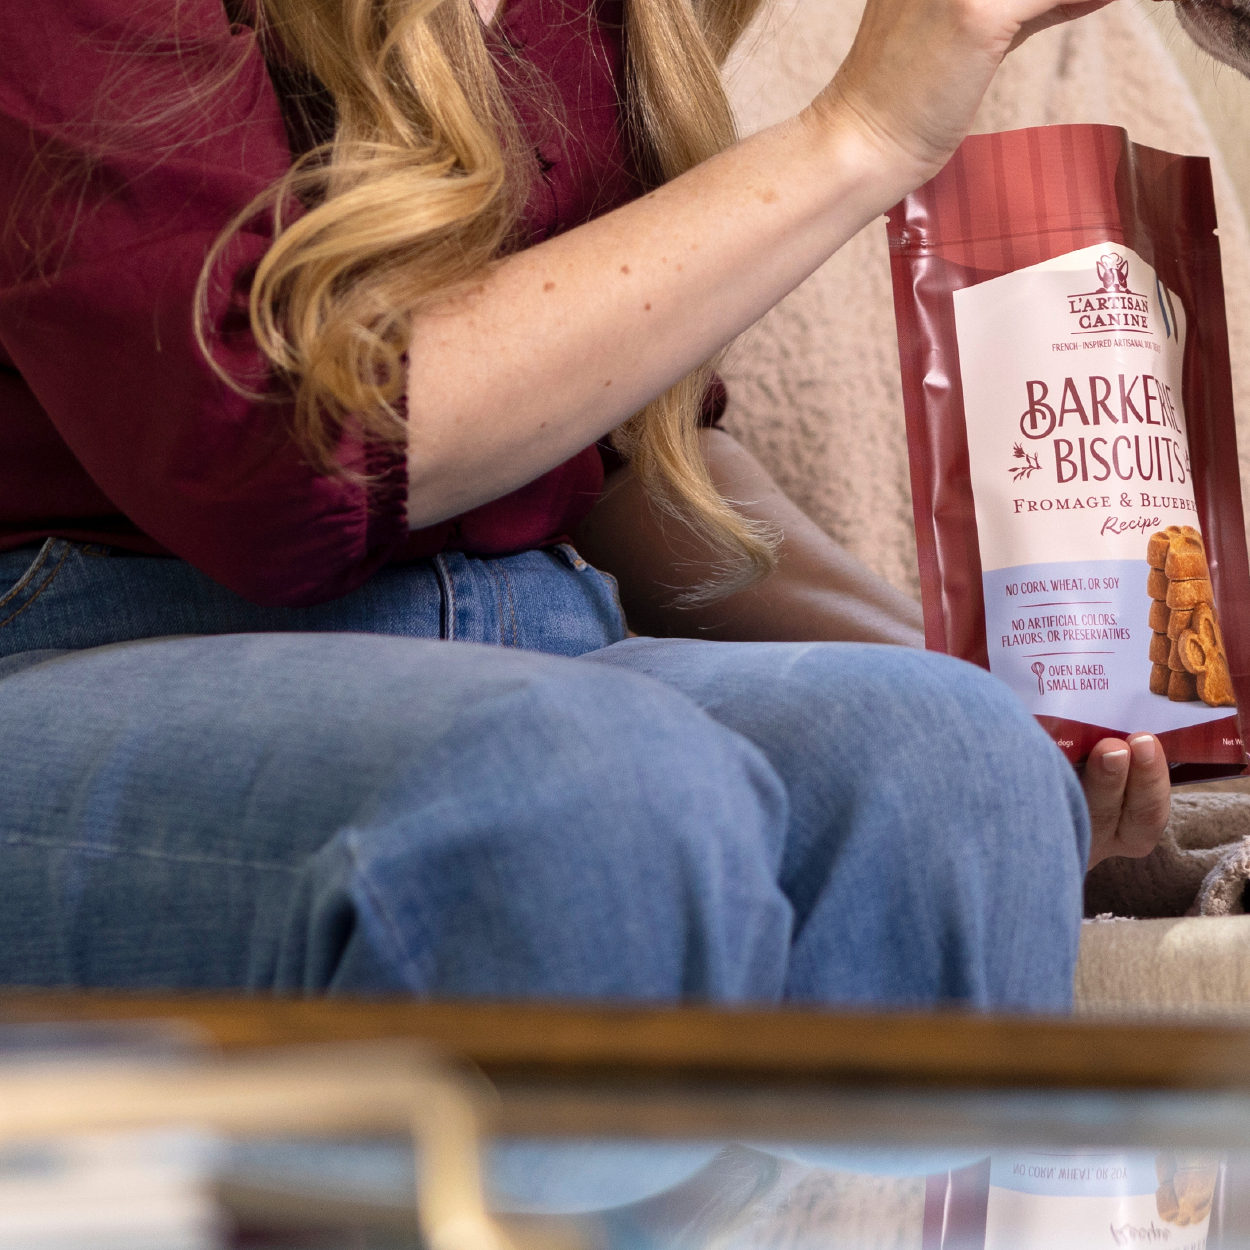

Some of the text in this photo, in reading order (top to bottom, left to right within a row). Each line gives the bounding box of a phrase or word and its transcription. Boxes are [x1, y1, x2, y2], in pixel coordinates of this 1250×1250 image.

[1068, 296, 1149, 313] L'ARTISAN
[1078, 313, 1148, 329] CANINE
[1020, 373, 1182, 440] BARKERIE
[1053, 434, 1186, 485] BISCUITS
[1119, 492, 1133, 508] &
[1100, 514, 1162, 536] Recipe
[1005, 583, 1019, 597] NO
[1087, 577, 1101, 590] OR
[1102, 576, 1120, 589] SOY
[1011, 613, 1118, 631] NO ARTIFICIAL COLORS,
[1047, 630, 1061, 643] OR
[1063, 627, 1131, 641] PRESERVATIVES
[1048, 664, 1073, 677] OVEN
[1046, 677, 1109, 691] SMALL BATCH
[1057, 737, 1074, 748] dogs
[1222, 737, 1234, 746] Net
